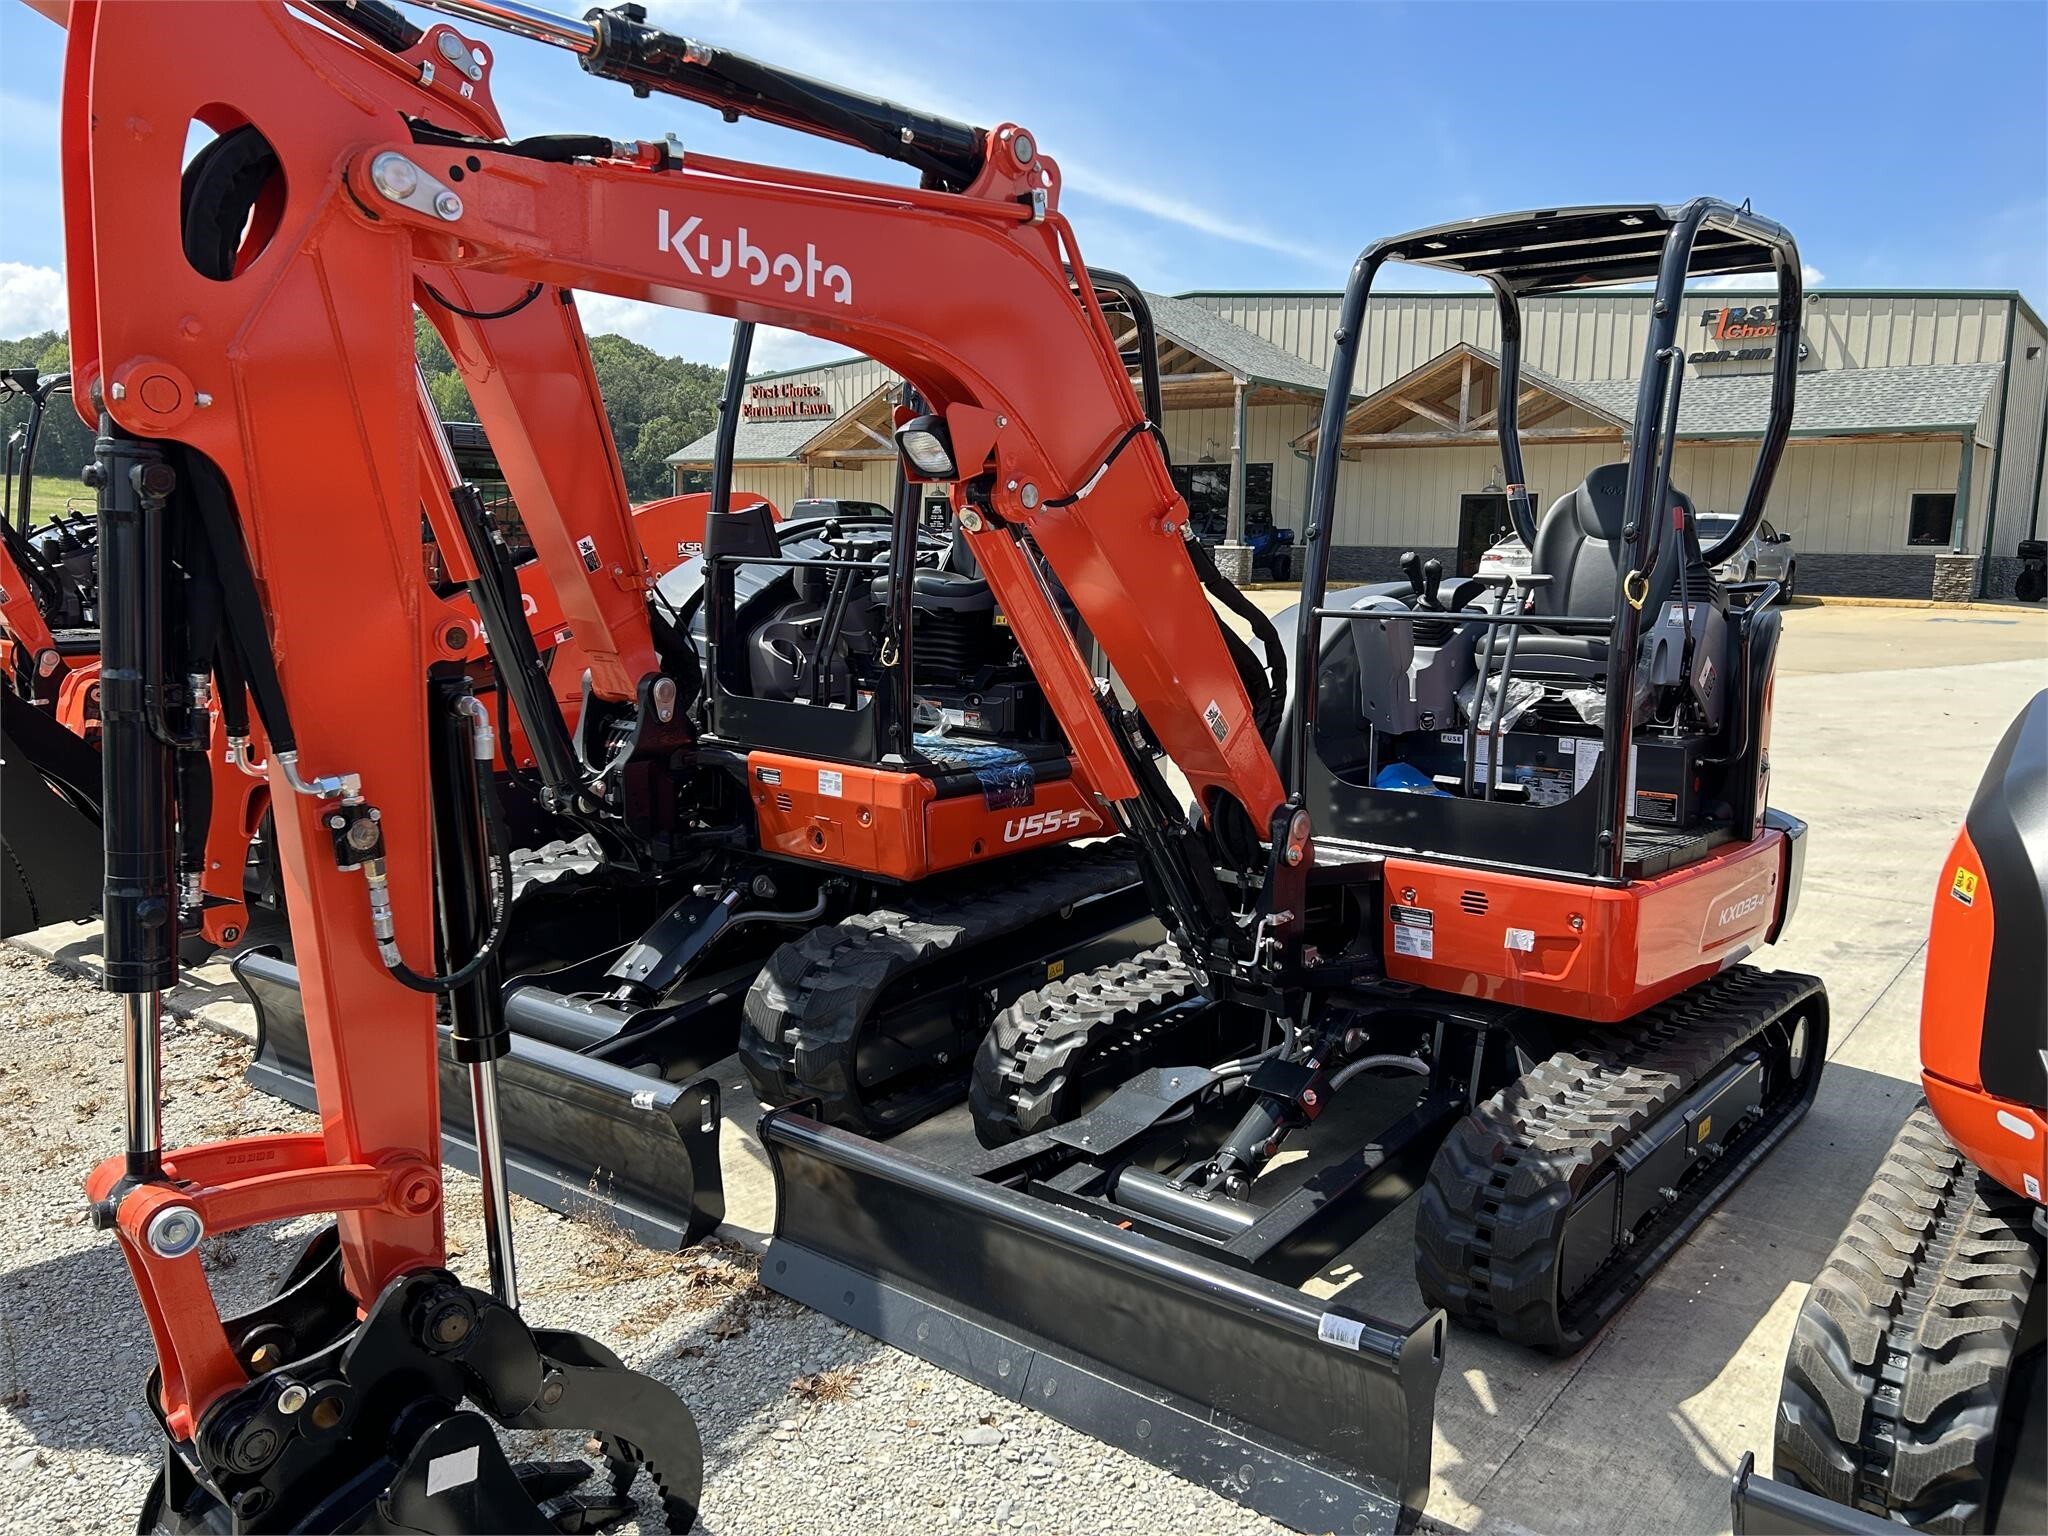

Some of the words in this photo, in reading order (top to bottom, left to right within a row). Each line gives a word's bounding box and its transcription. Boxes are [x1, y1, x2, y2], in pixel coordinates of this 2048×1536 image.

[658, 208, 852, 305] Kubota
[1726, 322, 1777, 338] Choi
[751, 384, 780, 399] First
[781, 383, 821, 398] Choice
[743, 403, 773, 418] Farm
[773, 401, 797, 416] and
[799, 401, 832, 415] Lawn
[677, 542, 703, 552] KSR
[1003, 809, 1081, 843] U55-5
[1718, 894, 1765, 927] KX033-4
